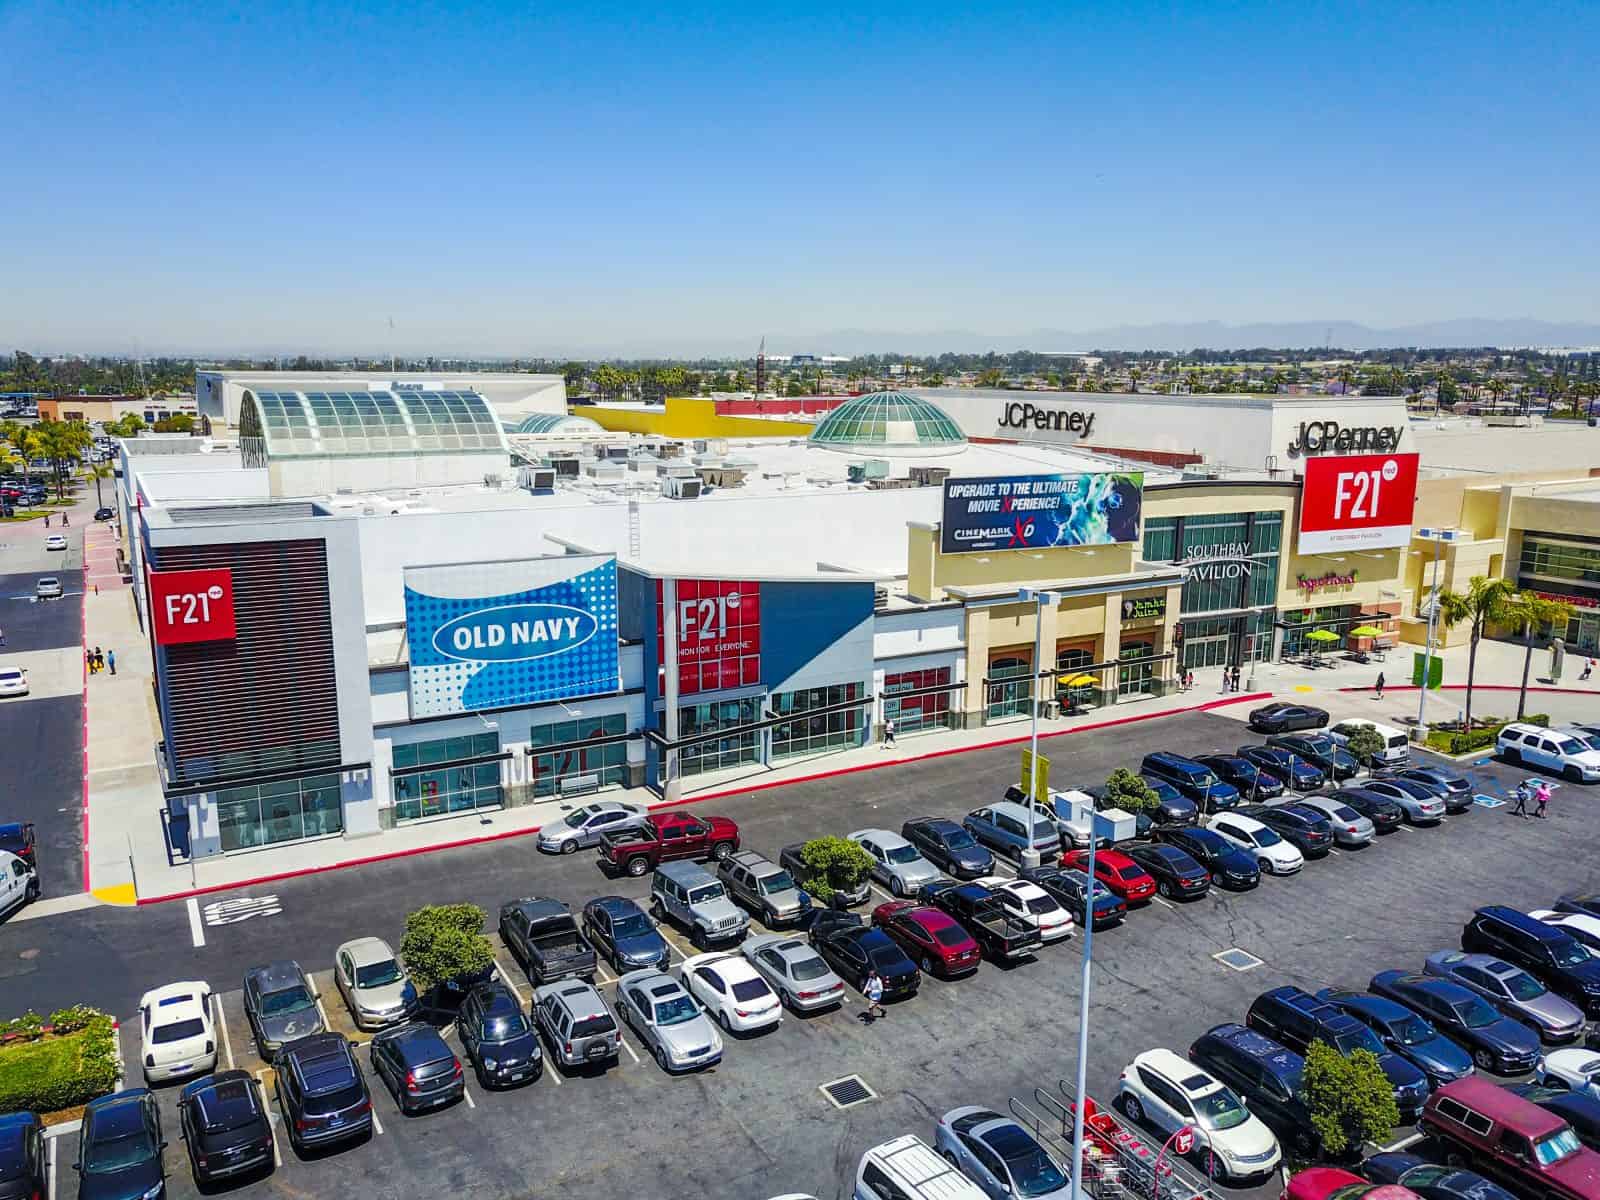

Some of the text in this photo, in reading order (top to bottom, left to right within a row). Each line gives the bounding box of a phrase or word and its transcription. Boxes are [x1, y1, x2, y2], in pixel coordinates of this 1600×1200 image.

[998, 402, 1095, 439] JCPenney
[1288, 421, 1404, 454] JCPenney
[949, 480, 1079, 498] UPGRADE TO THE ULTIMATE
[967, 495, 1060, 513] MOVIE XPERIENCE!
[1333, 470, 1381, 520] F21
[1187, 541, 1251, 558] SOUTHBAY
[1180, 562, 1253, 583] PAVILION
[165, 592, 210, 625] F21
[680, 596, 727, 642] F21
[453, 616, 580, 650] OLD NAVY
